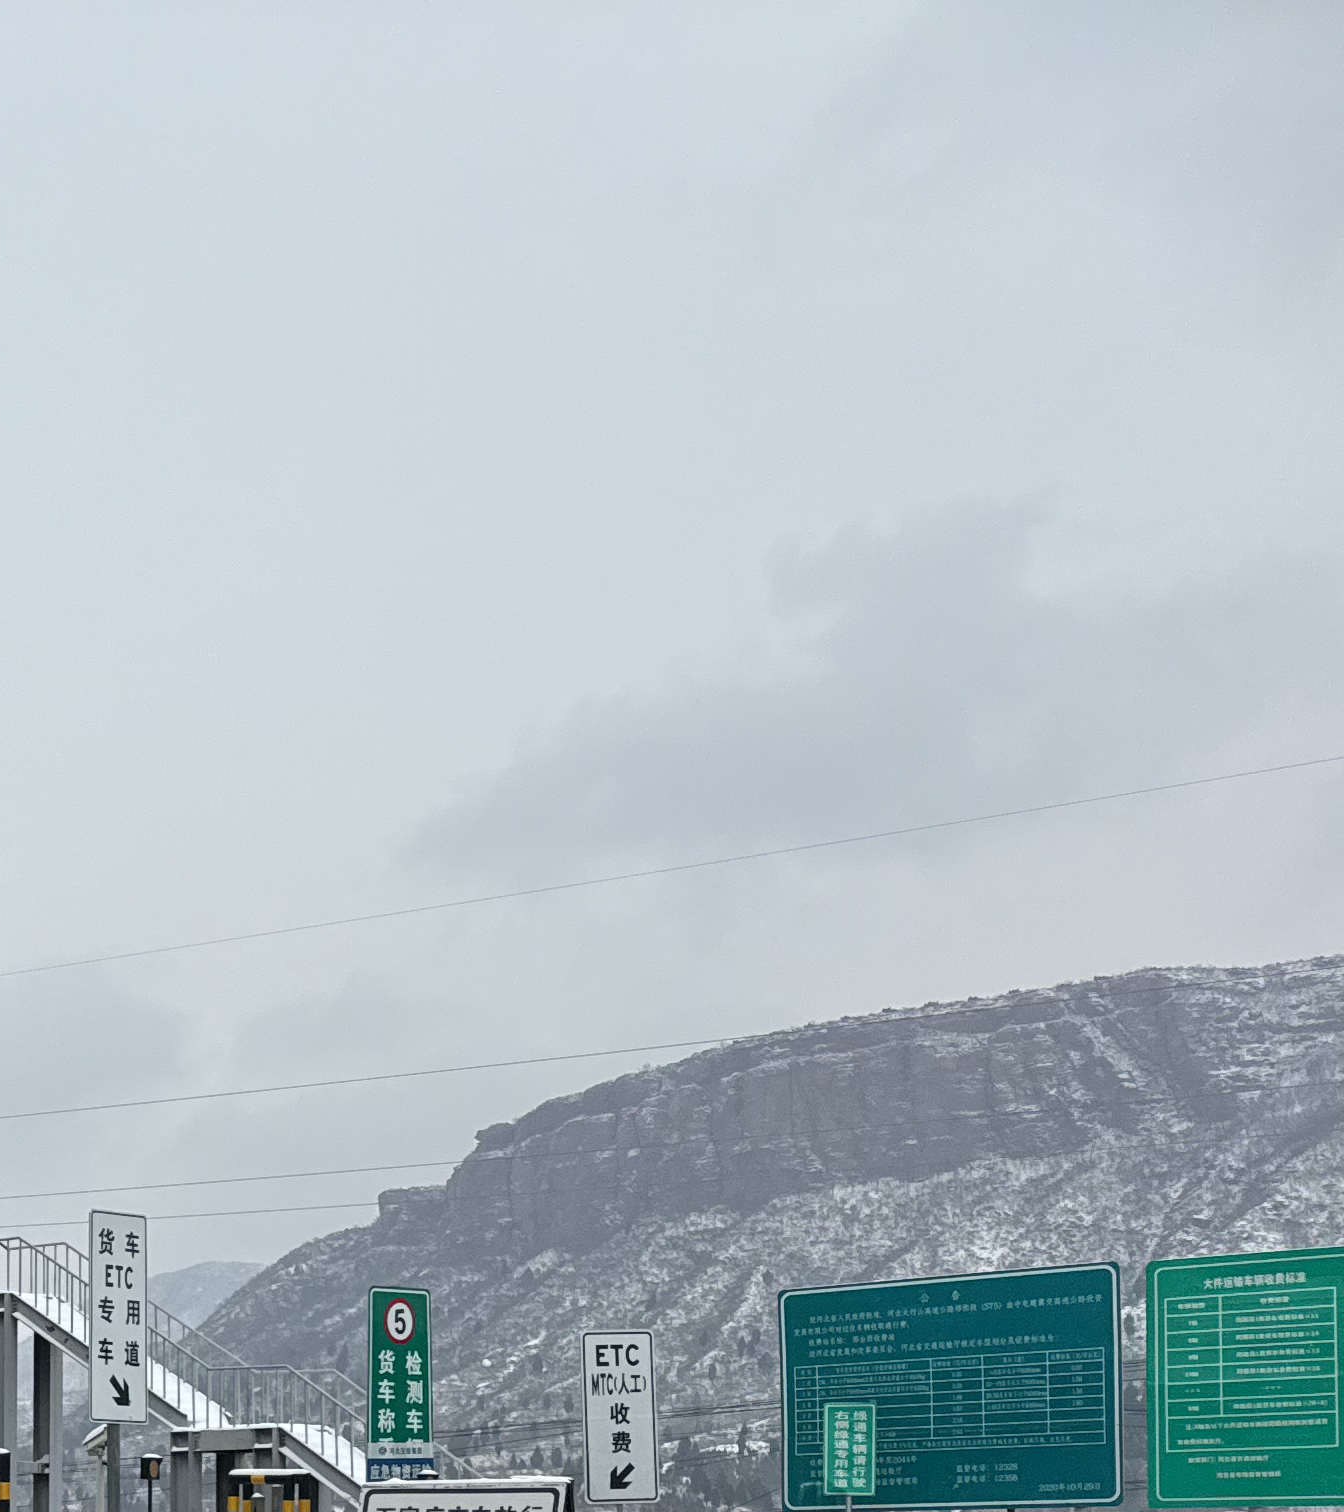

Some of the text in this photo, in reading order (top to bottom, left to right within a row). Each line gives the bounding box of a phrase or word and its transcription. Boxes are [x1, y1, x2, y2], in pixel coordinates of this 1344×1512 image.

[98, 1228, 140, 1259] 货车
[105, 1264, 134, 1289] ETC
[1203, 1272, 1307, 1290] 大件运输车辆收费标准
[97, 1296, 141, 1326] 专用
[394, 1308, 407, 1335] 5
[97, 1337, 140, 1367] 车道
[596, 1344, 640, 1367] ETC
[377, 1350, 396, 1442] 货车称
[405, 1350, 424, 1444] 检测车
[610, 1402, 631, 1453] 收费
